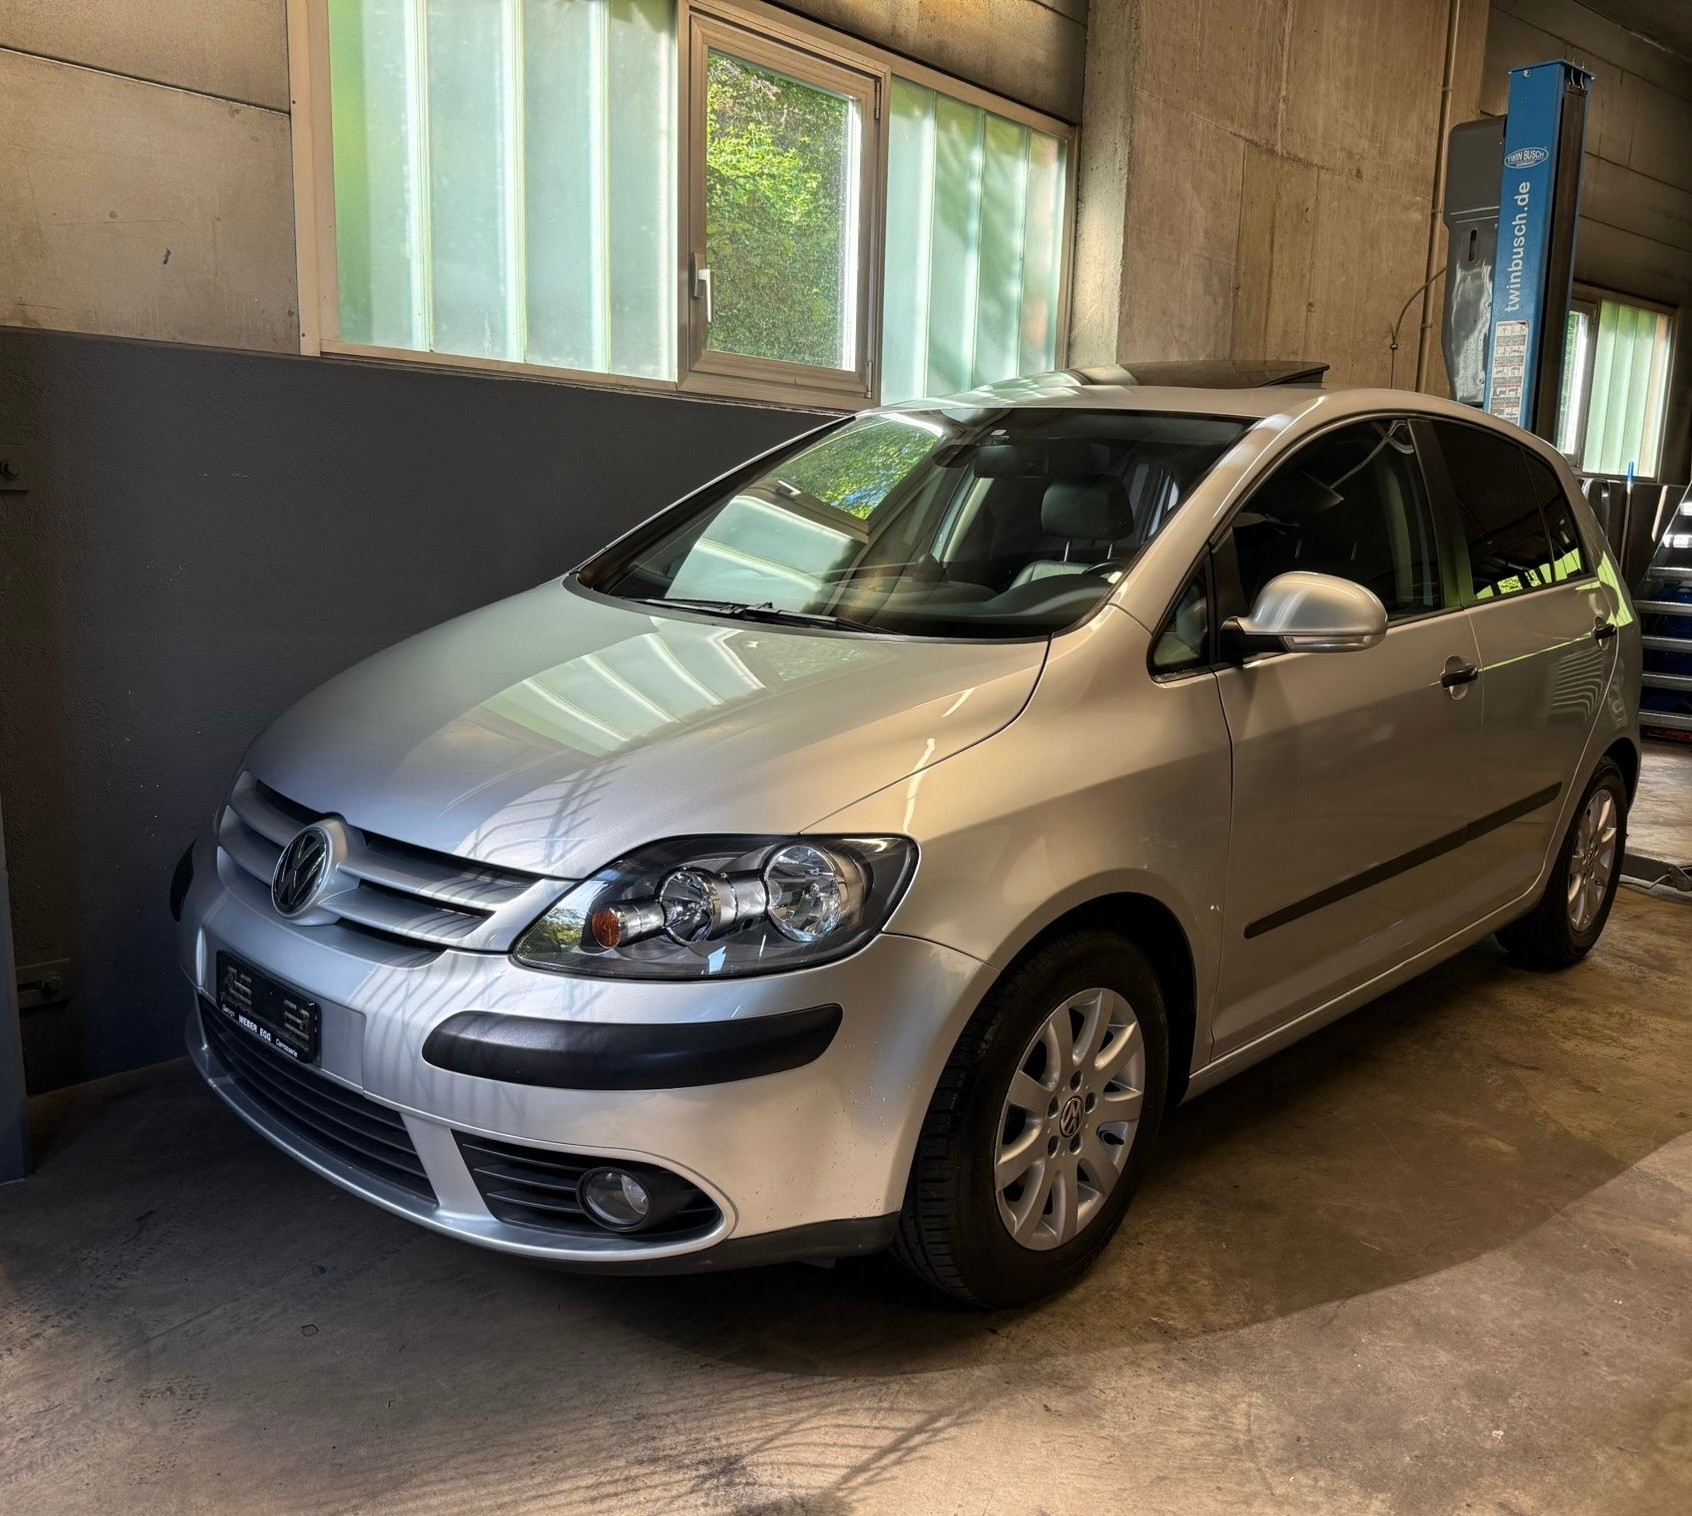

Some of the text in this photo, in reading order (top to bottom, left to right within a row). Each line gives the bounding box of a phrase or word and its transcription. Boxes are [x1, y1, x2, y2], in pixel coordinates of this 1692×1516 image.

[1507, 151, 1523, 164] TWIN
[1504, 181, 1531, 312] twinbusch.de
[238, 1014, 258, 1033] WEBER
